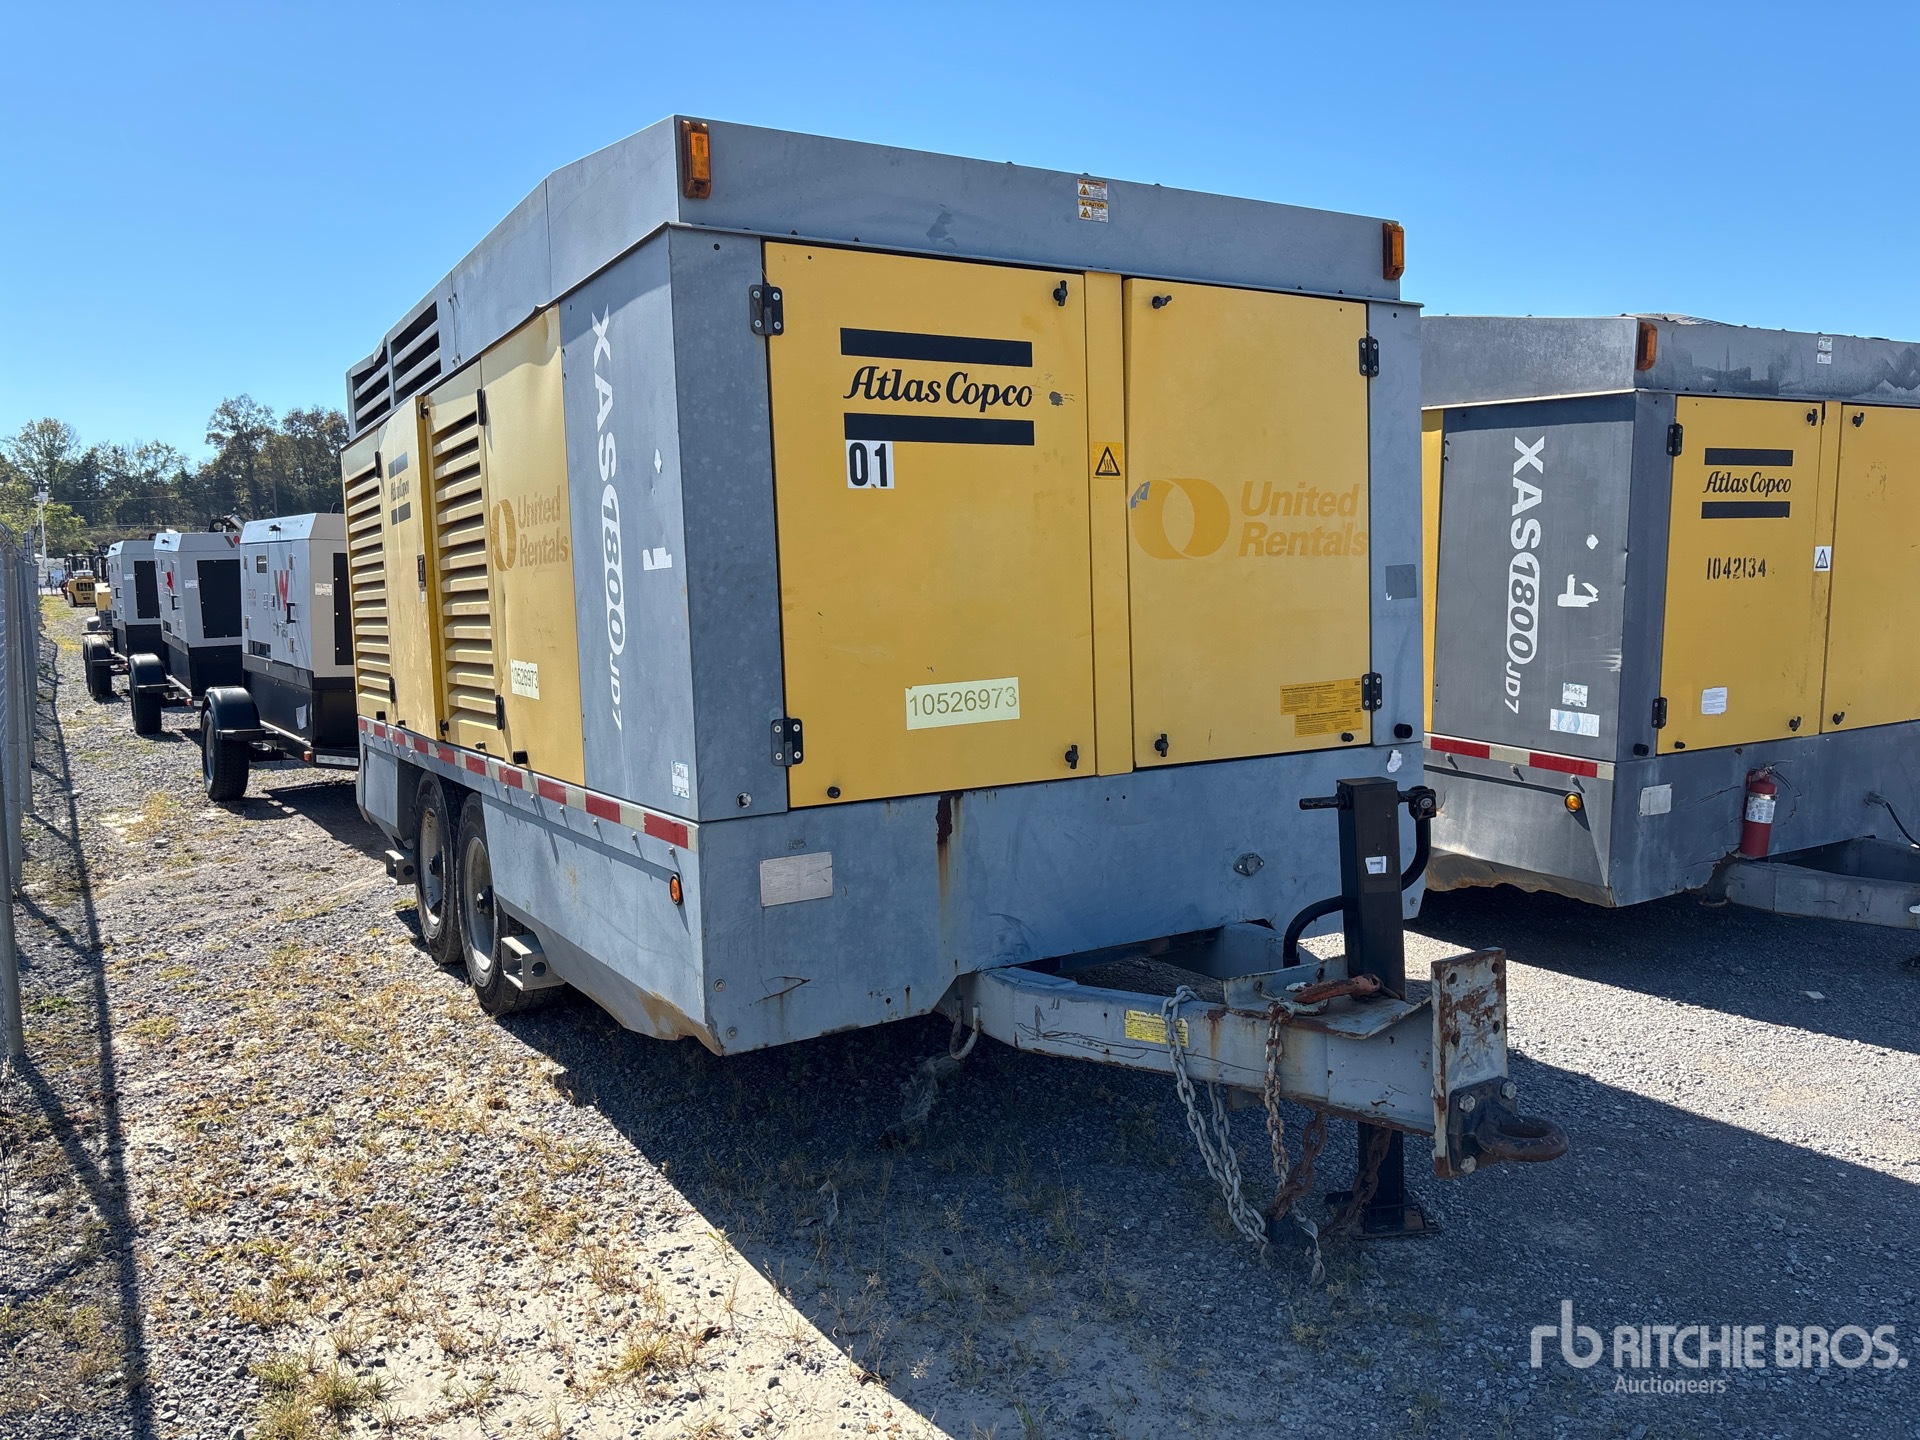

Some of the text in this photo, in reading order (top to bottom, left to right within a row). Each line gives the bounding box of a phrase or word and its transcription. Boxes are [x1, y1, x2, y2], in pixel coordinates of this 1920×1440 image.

[843, 366, 1033, 413] Atlas Copco
[849, 442, 888, 488] 01
[1703, 470, 1791, 497] Atlas Copco
[518, 485, 561, 529] United
[1241, 480, 1360, 517] United
[520, 527, 568, 567] Rentals
[1238, 521, 1368, 557] Rentals
[1706, 556, 1766, 580] 1042134
[910, 686, 1017, 717] 10526973
